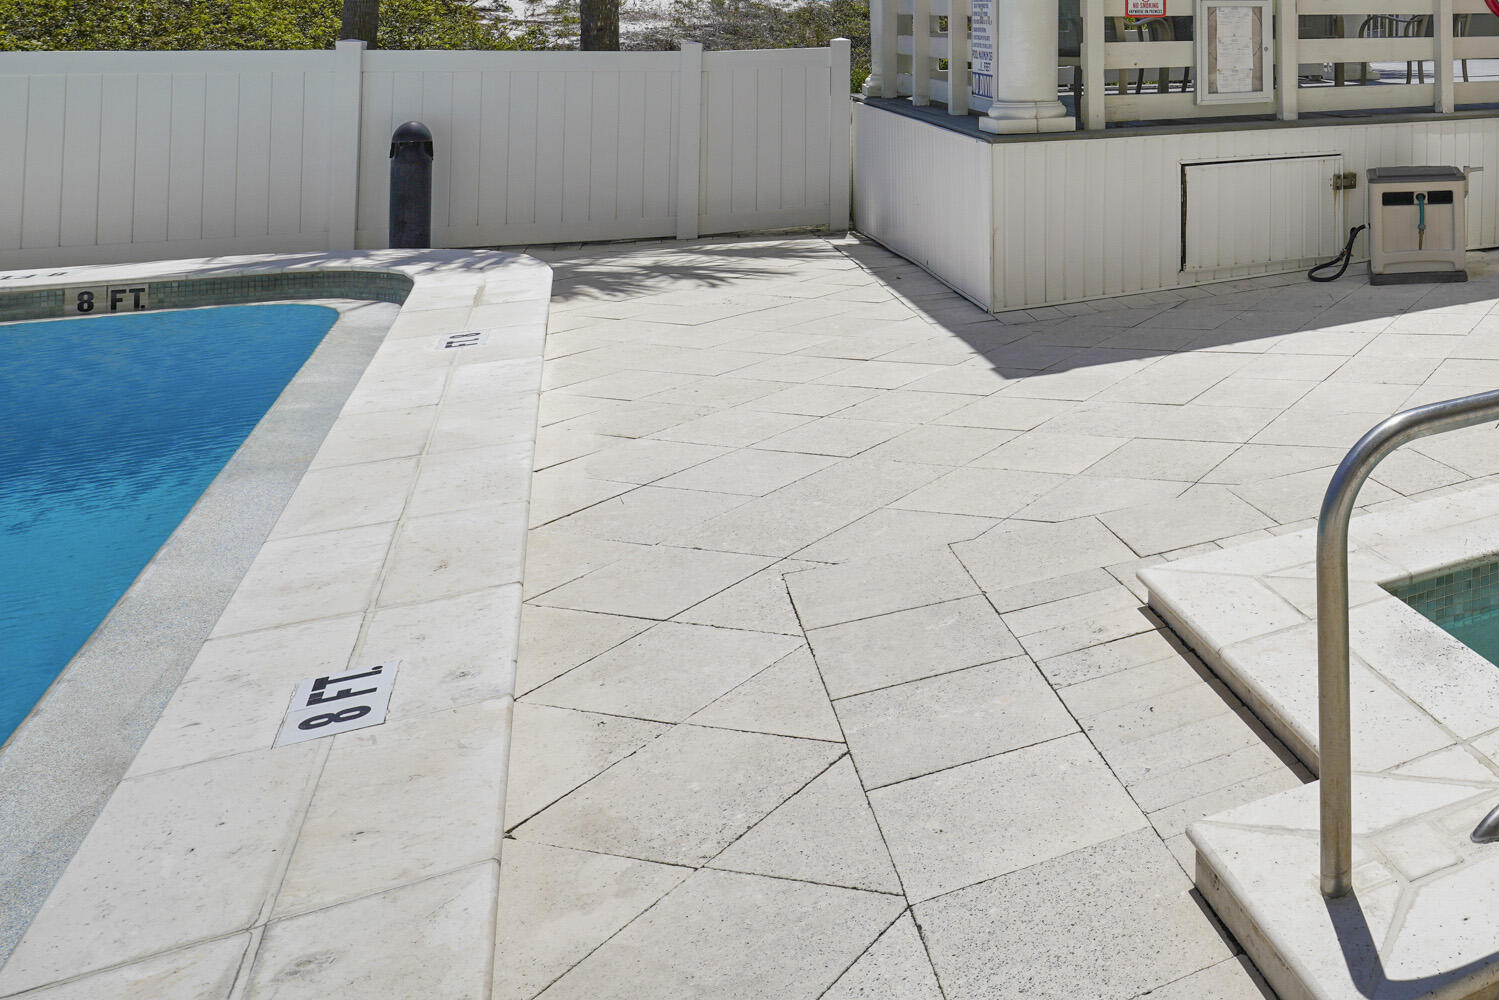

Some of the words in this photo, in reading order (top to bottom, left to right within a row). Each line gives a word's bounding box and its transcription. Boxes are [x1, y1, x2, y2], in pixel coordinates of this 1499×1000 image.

[77, 290, 94, 312] 8
[110, 288, 146, 310] FT.
[306, 666, 384, 706] FT.
[298, 705, 372, 730] 8
